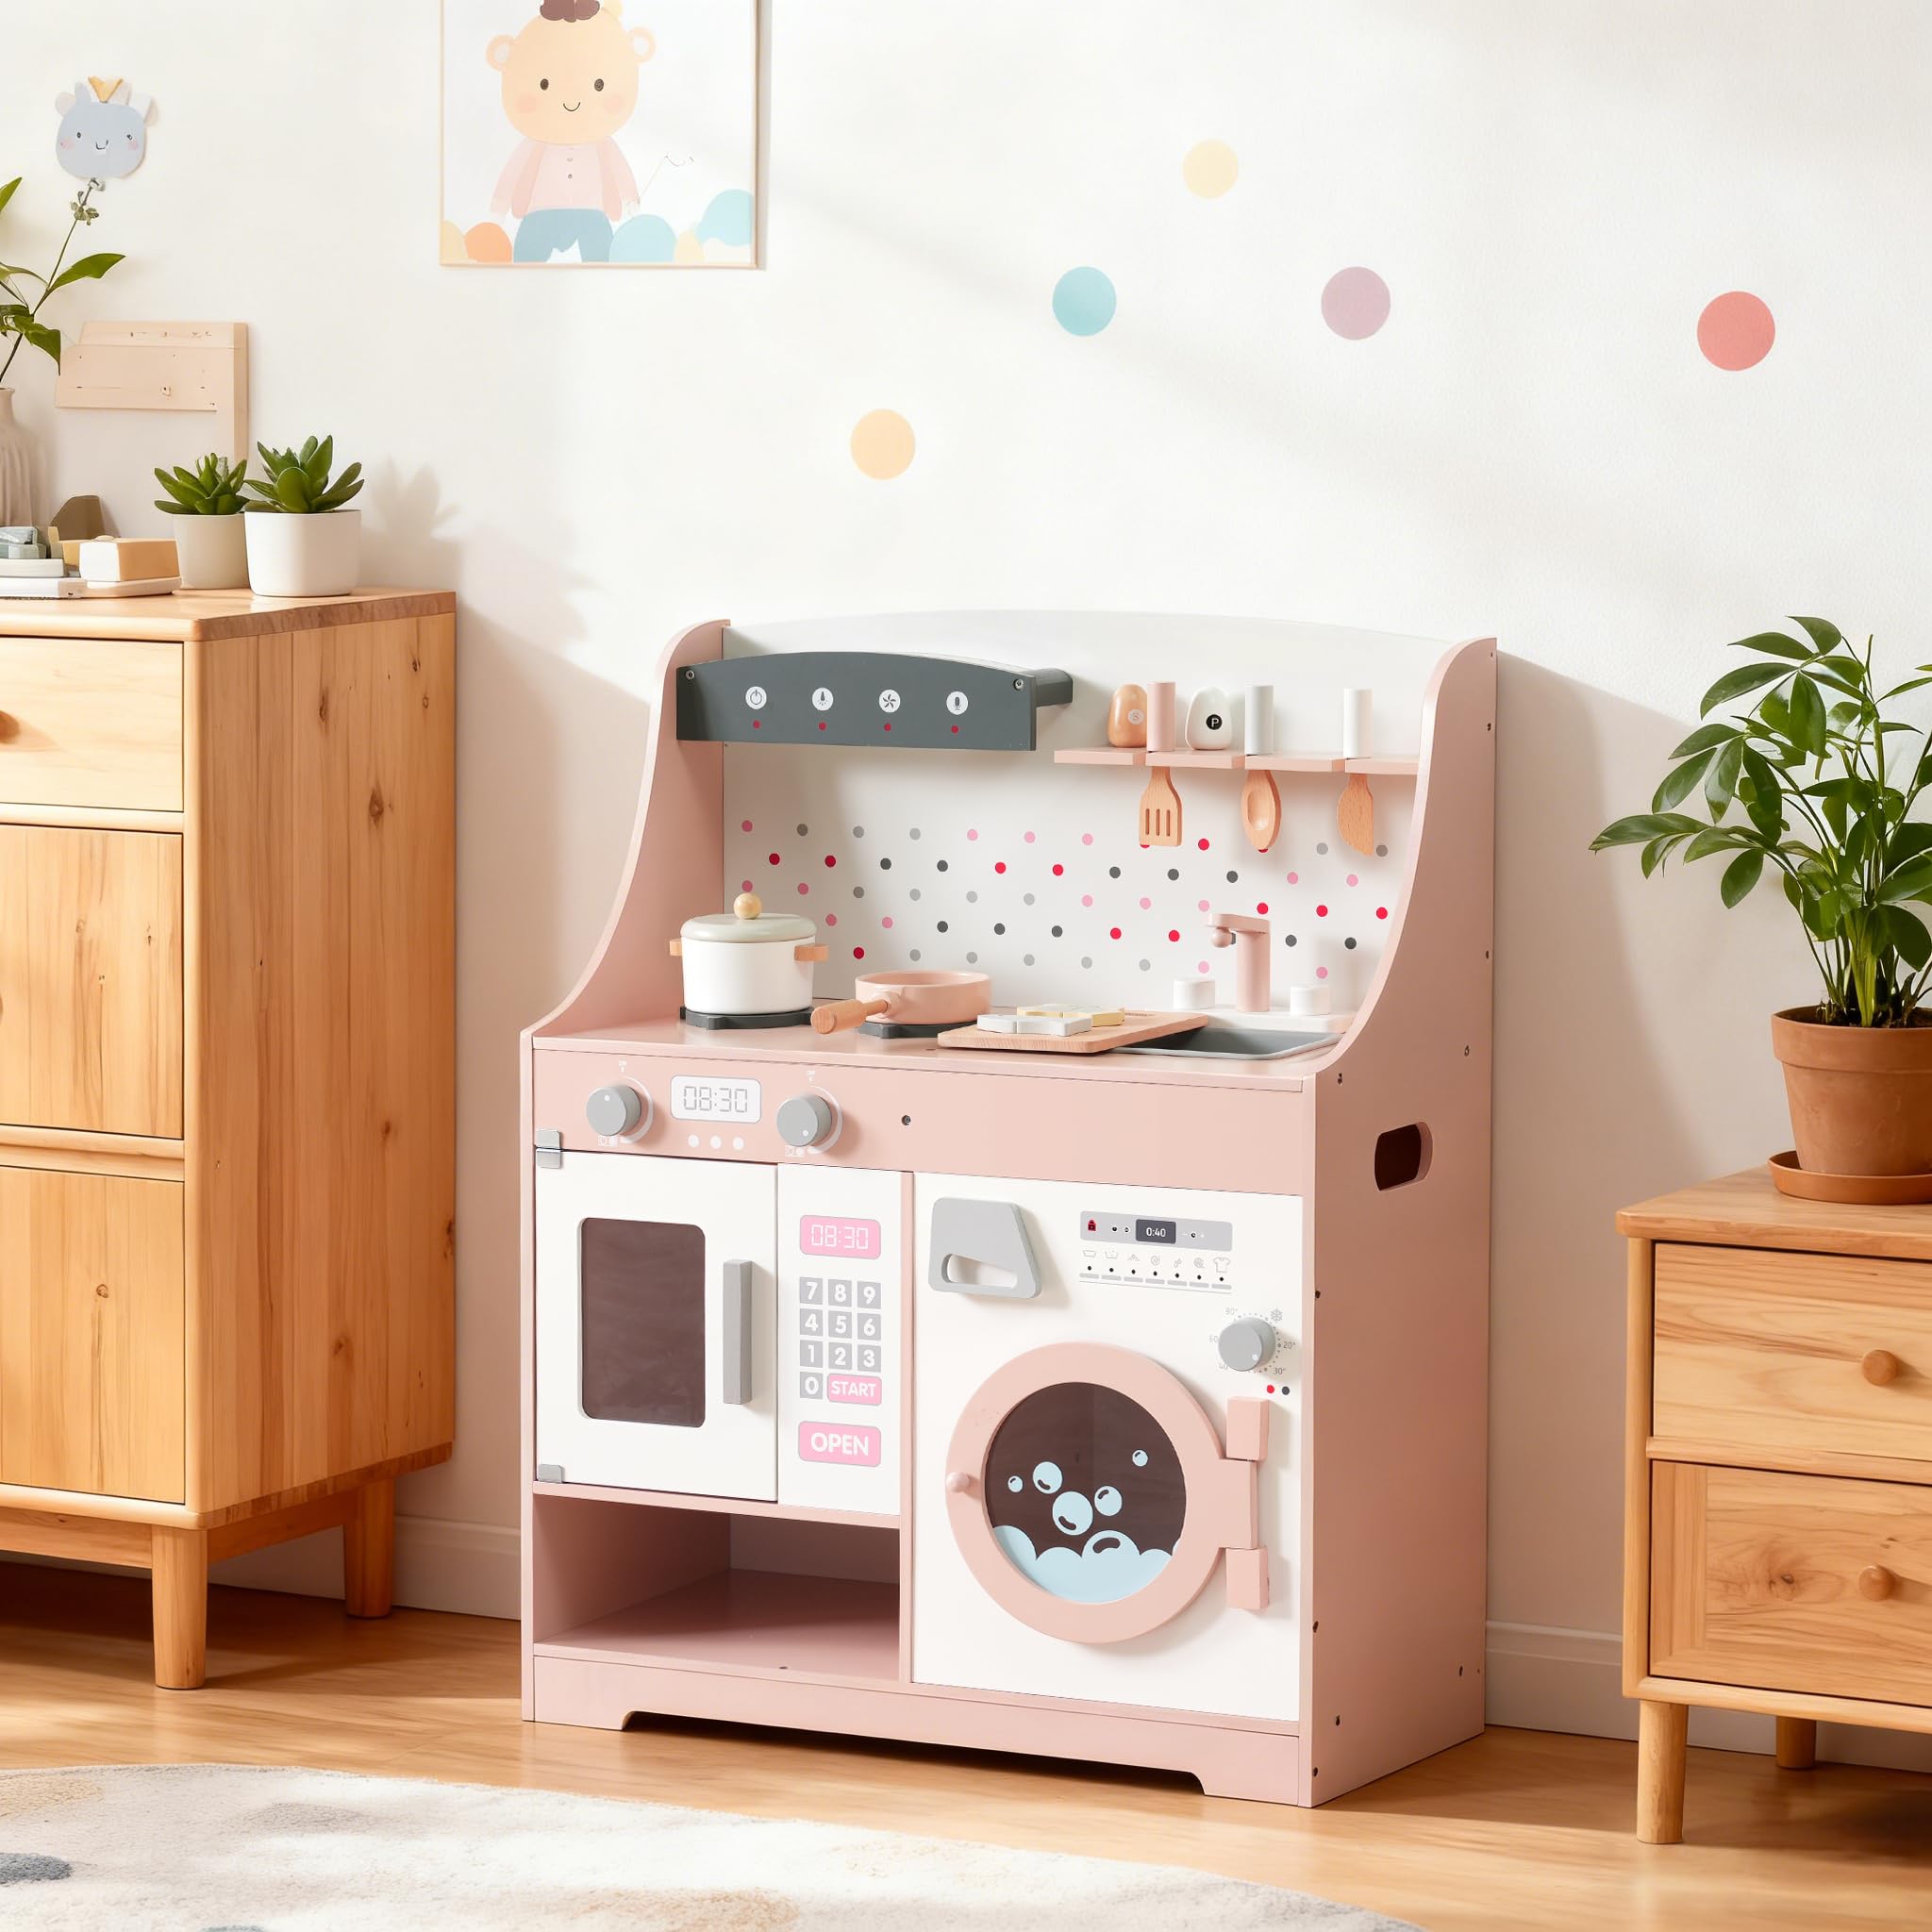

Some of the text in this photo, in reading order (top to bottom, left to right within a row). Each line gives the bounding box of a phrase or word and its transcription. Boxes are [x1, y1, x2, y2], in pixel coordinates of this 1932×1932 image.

[1211, 718, 1220, 727] P
[684, 1086, 748, 1112] 08:30
[811, 1224, 869, 1249] 08:30
[1146, 1226, 1166, 1238] 0:40
[806, 1281, 876, 1305] 7 8 9
[805, 1313, 876, 1336] 4 5 6
[808, 1344, 875, 1367] 1 2 3
[805, 1376, 819, 1395] 0
[831, 1380, 876, 1396] START
[811, 1432, 870, 1457] OPEN
